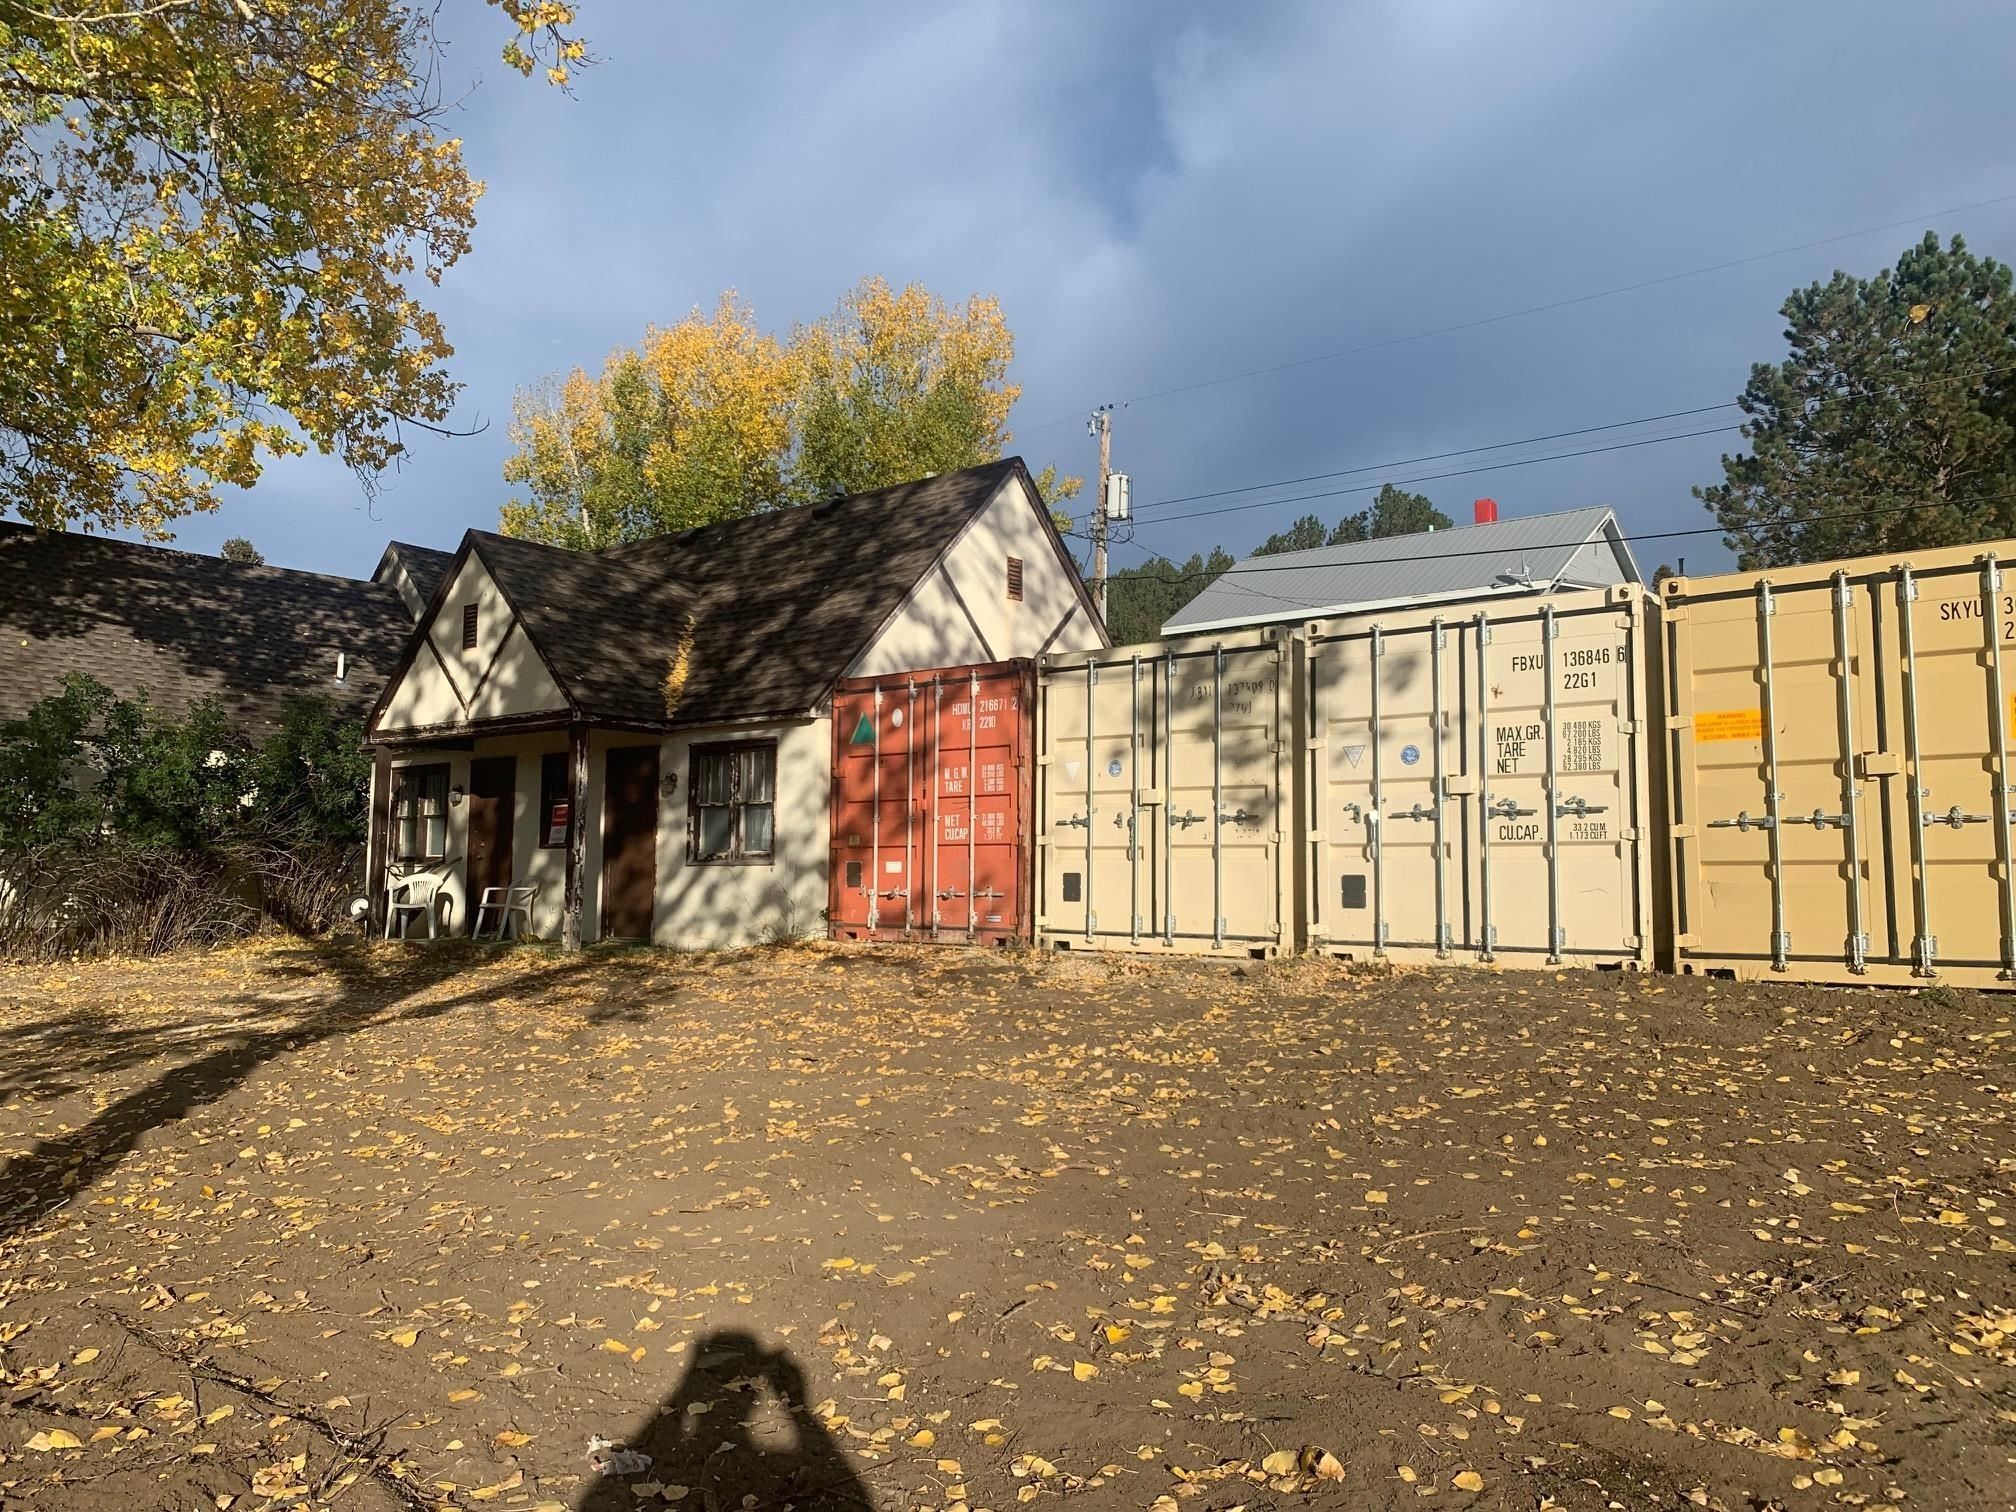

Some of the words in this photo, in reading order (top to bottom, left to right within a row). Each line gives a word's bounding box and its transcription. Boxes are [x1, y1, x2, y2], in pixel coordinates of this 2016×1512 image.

[1940, 600, 1984, 620] SKYU
[1512, 654, 1544, 672] FBXU
[1563, 648, 1610, 668] 136846
[1617, 646, 1625, 662] 6
[1564, 672, 1596, 689] 22G1
[1496, 725, 1544, 742] MAX.GR.
[1497, 742, 1526, 757] TARE
[1497, 758, 1519, 773] NET
[944, 780, 963, 793] TARE
[944, 814, 960, 827] NET
[1499, 824, 1543, 840] CU.CAP.
